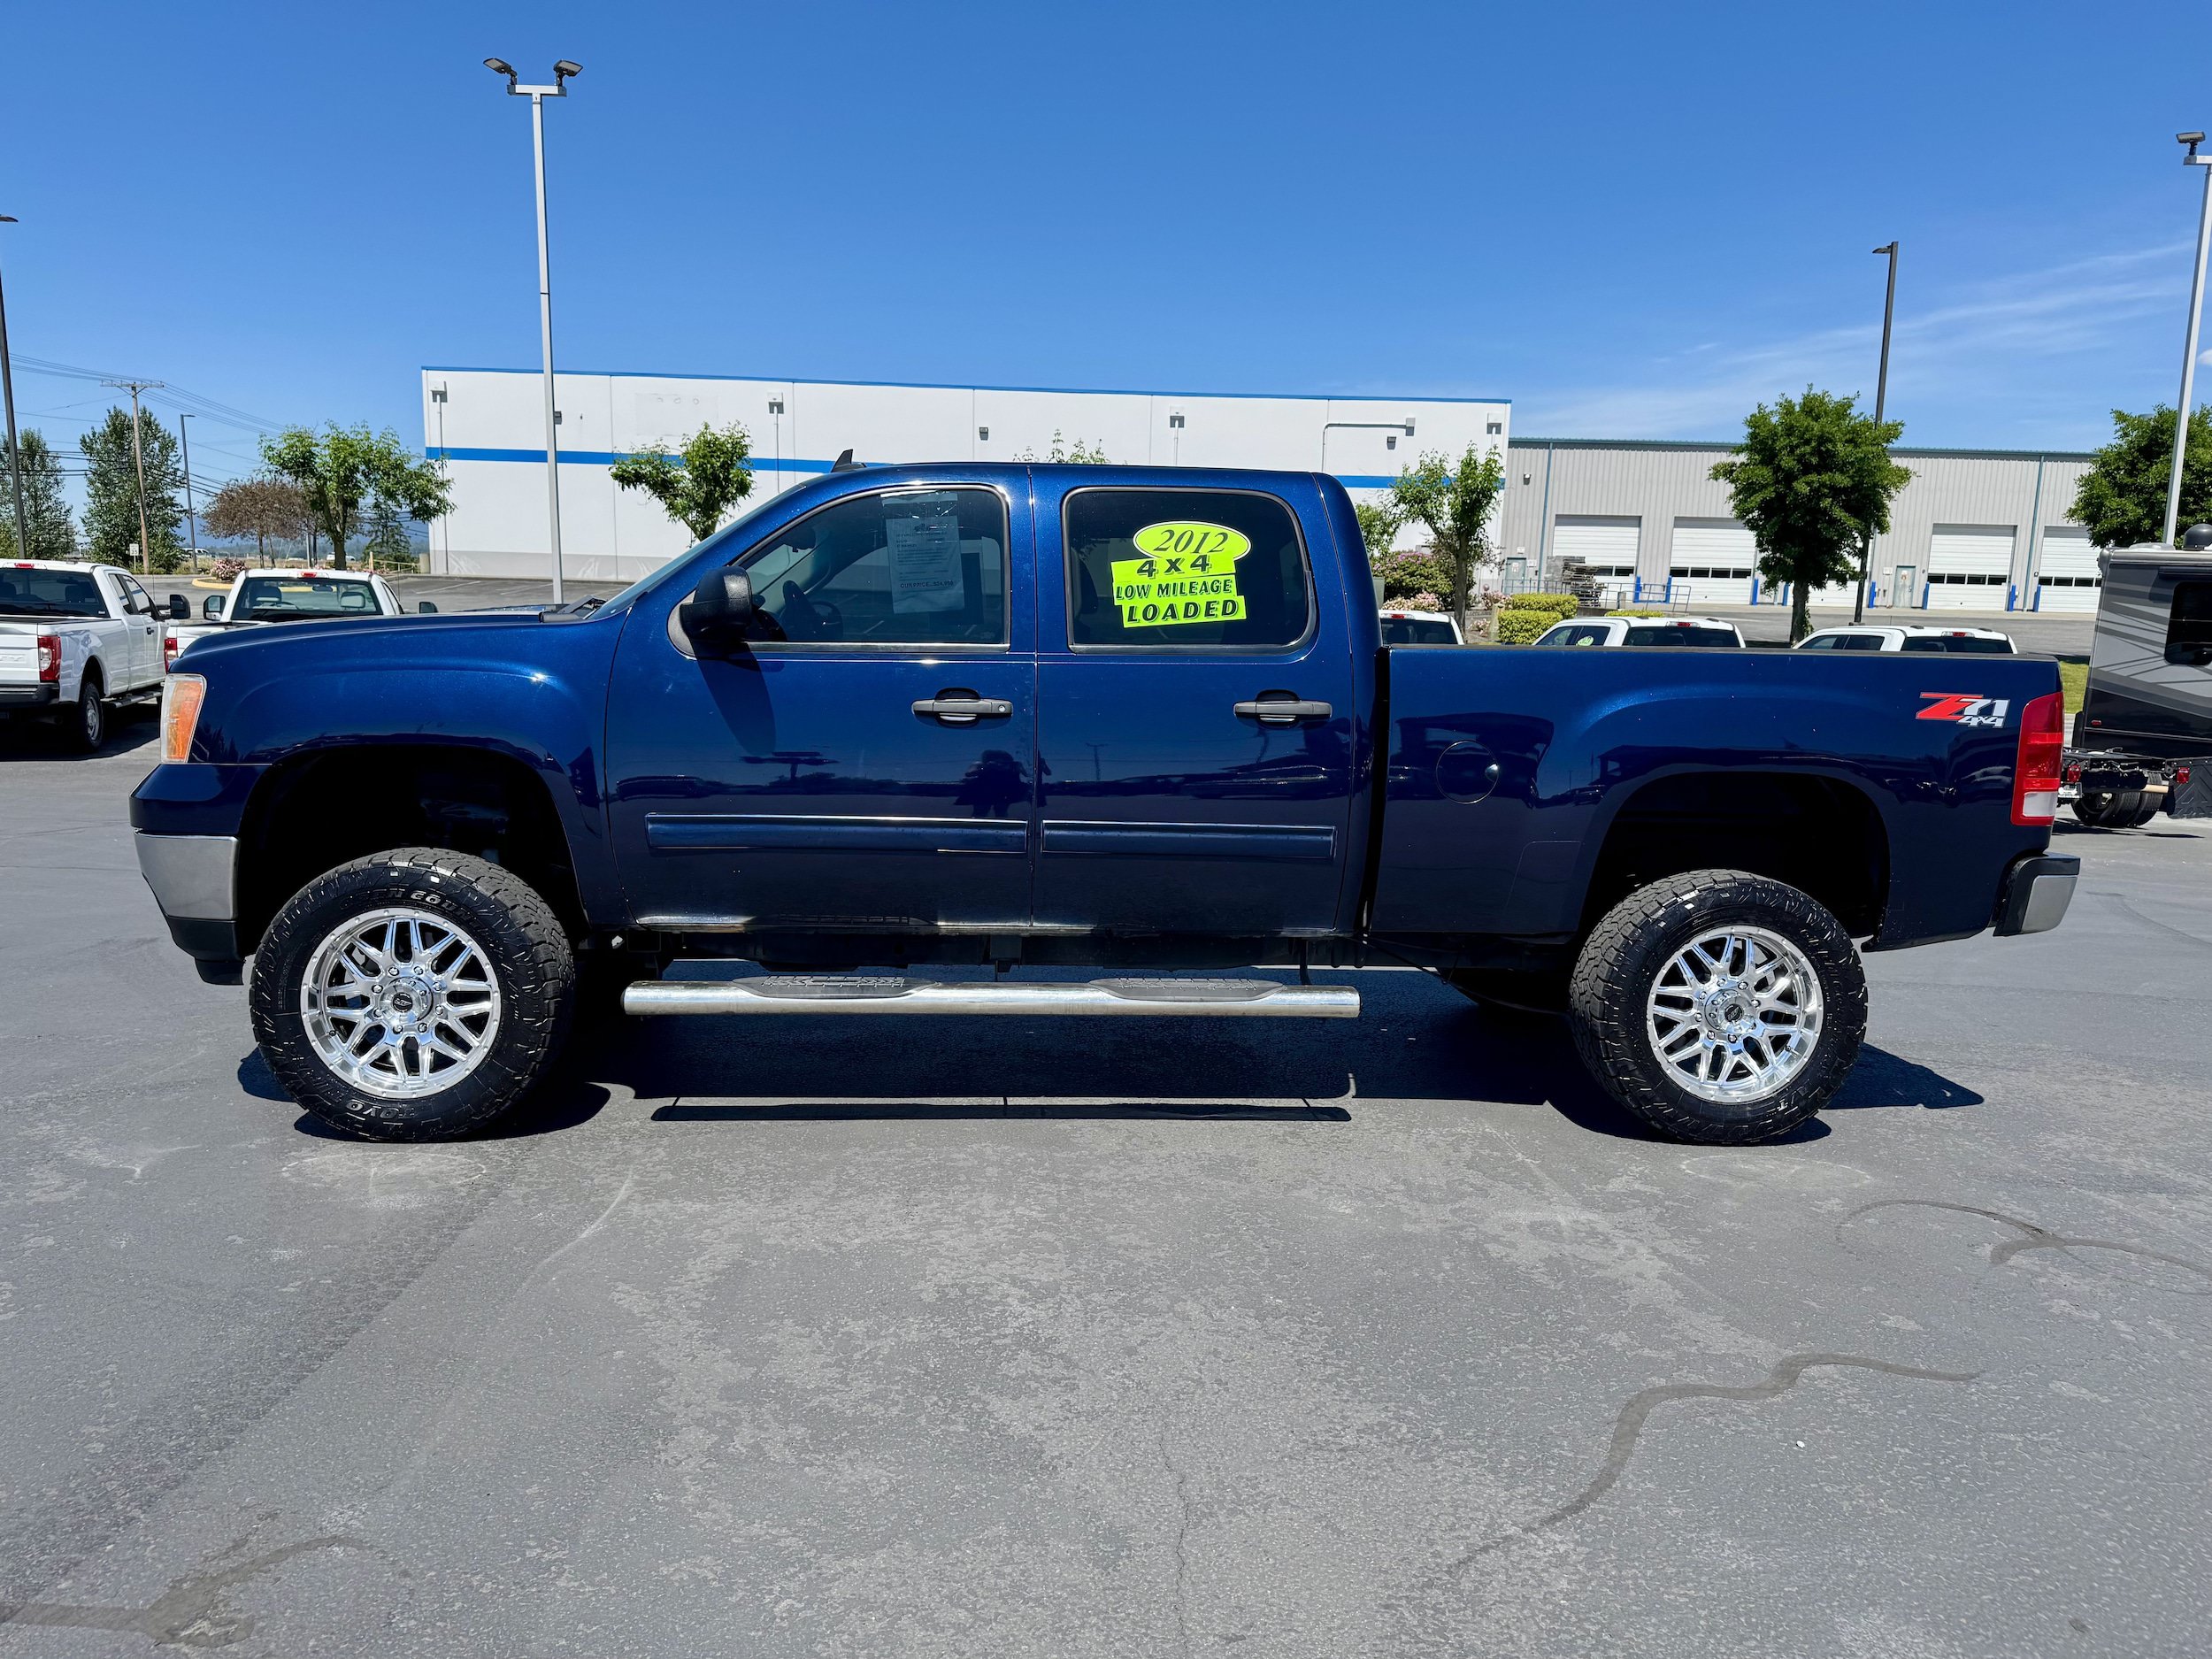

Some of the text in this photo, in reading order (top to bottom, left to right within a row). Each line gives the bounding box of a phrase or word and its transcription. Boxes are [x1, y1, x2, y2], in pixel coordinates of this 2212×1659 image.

[1153, 529, 1229, 554] 2012
[1116, 579, 1233, 600] LOW MILEAGE
[1127, 599, 1239, 623] LOADED
[1916, 692, 2011, 719] Z71
